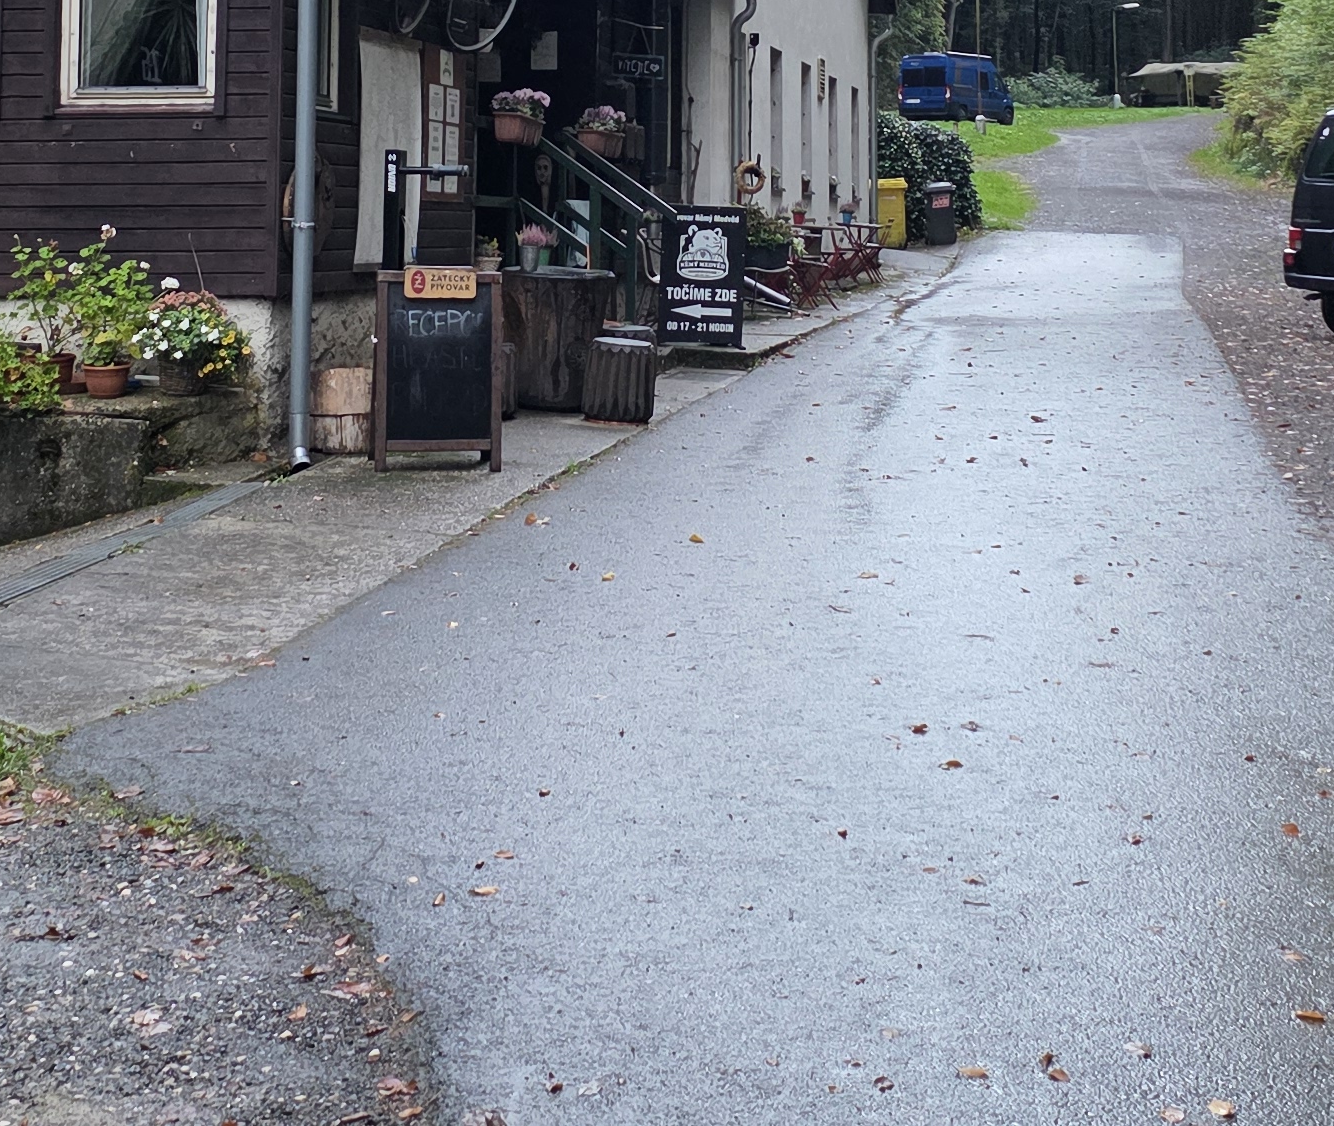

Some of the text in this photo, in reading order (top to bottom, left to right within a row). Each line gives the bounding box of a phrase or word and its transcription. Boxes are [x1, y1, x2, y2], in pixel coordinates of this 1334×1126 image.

[430, 283, 471, 292] PIVOVAR
[666, 284, 737, 302] TOČÍME ZDE
[680, 321, 690, 331] 17
[696, 322, 707, 332] 21
